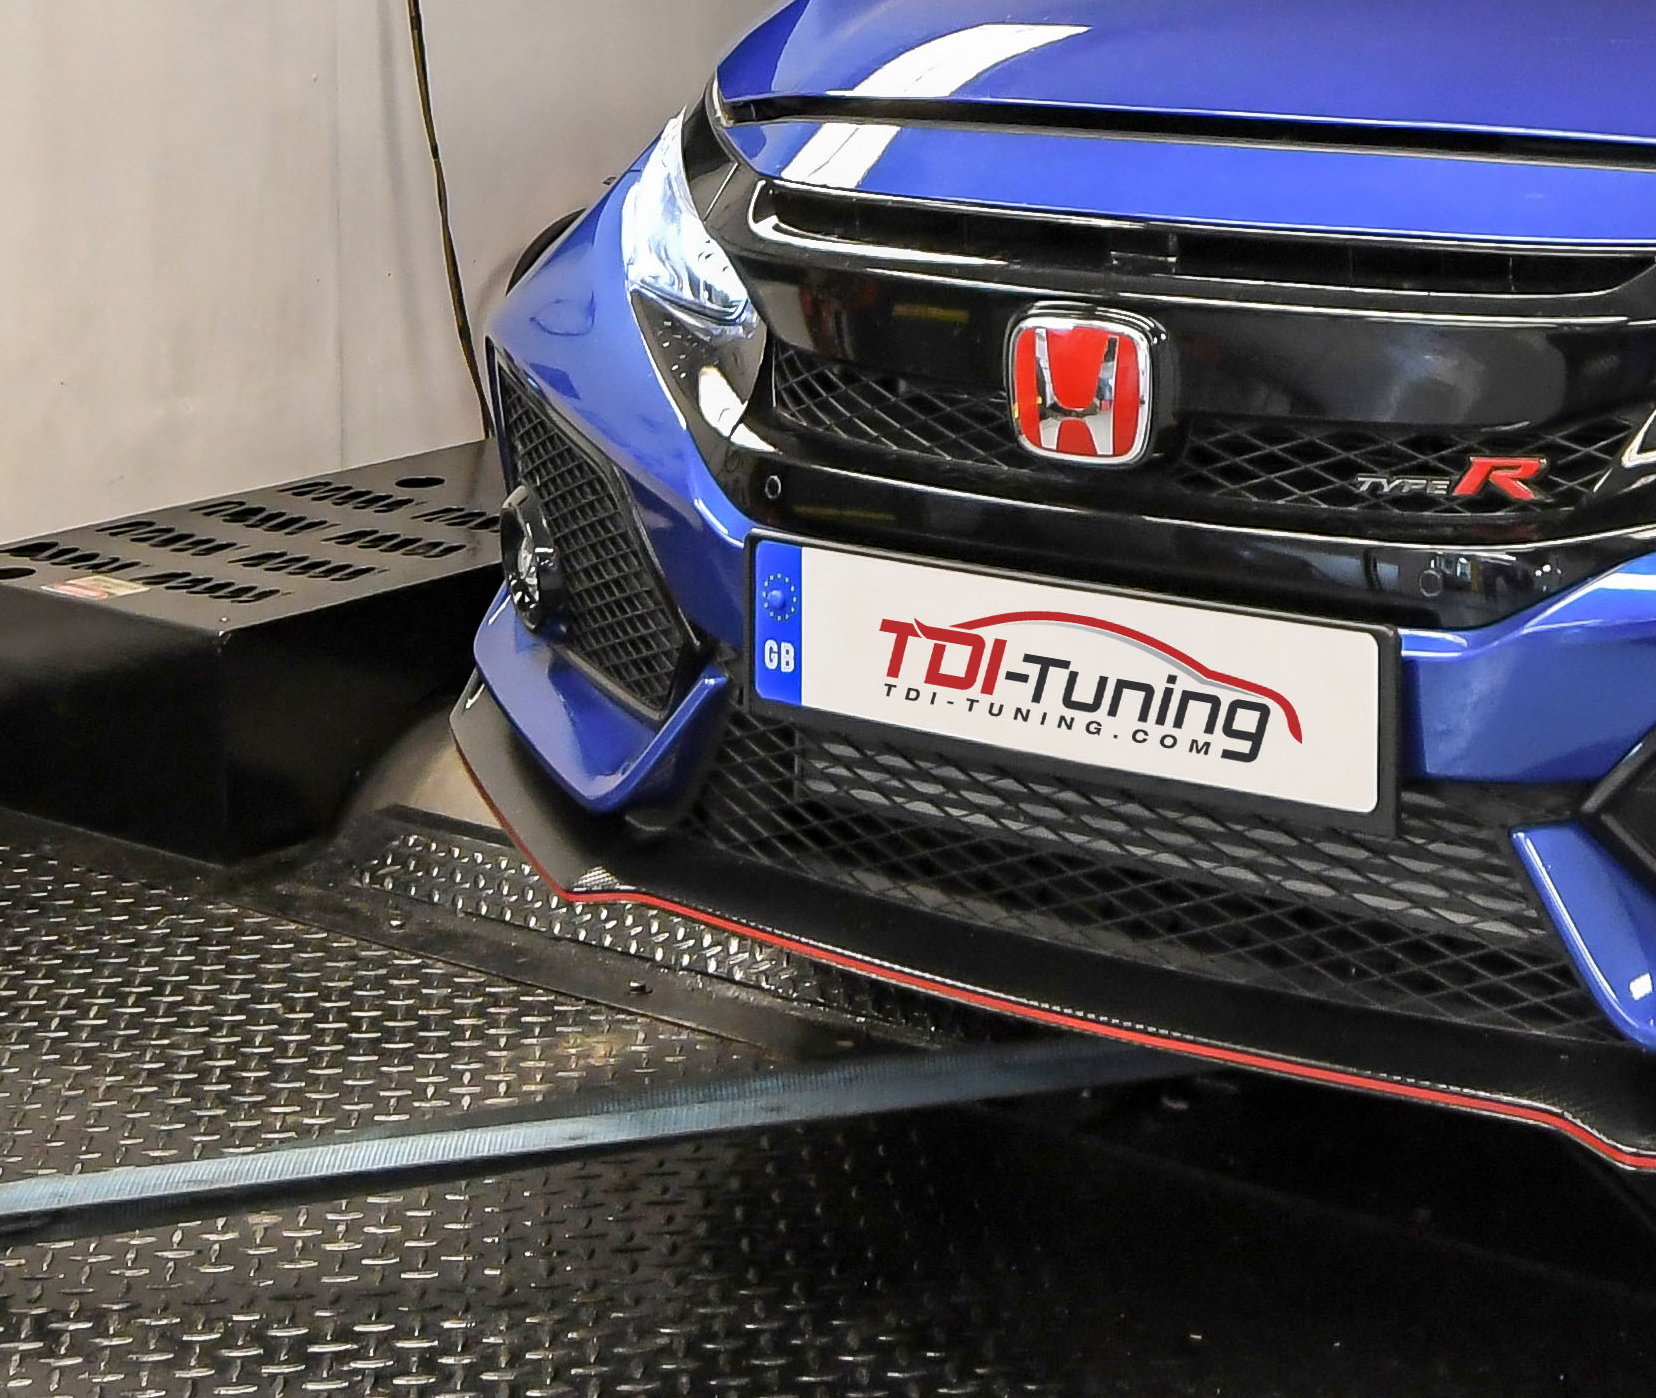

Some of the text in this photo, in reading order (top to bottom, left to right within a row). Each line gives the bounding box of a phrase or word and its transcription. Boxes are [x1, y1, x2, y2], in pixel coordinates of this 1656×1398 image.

[1355, 456, 1547, 500] TYPE R
[764, 639, 796, 674] GB
[879, 617, 1271, 763] TDI-Tuning
[883, 683, 1211, 757] TDI-TUNING.COM
